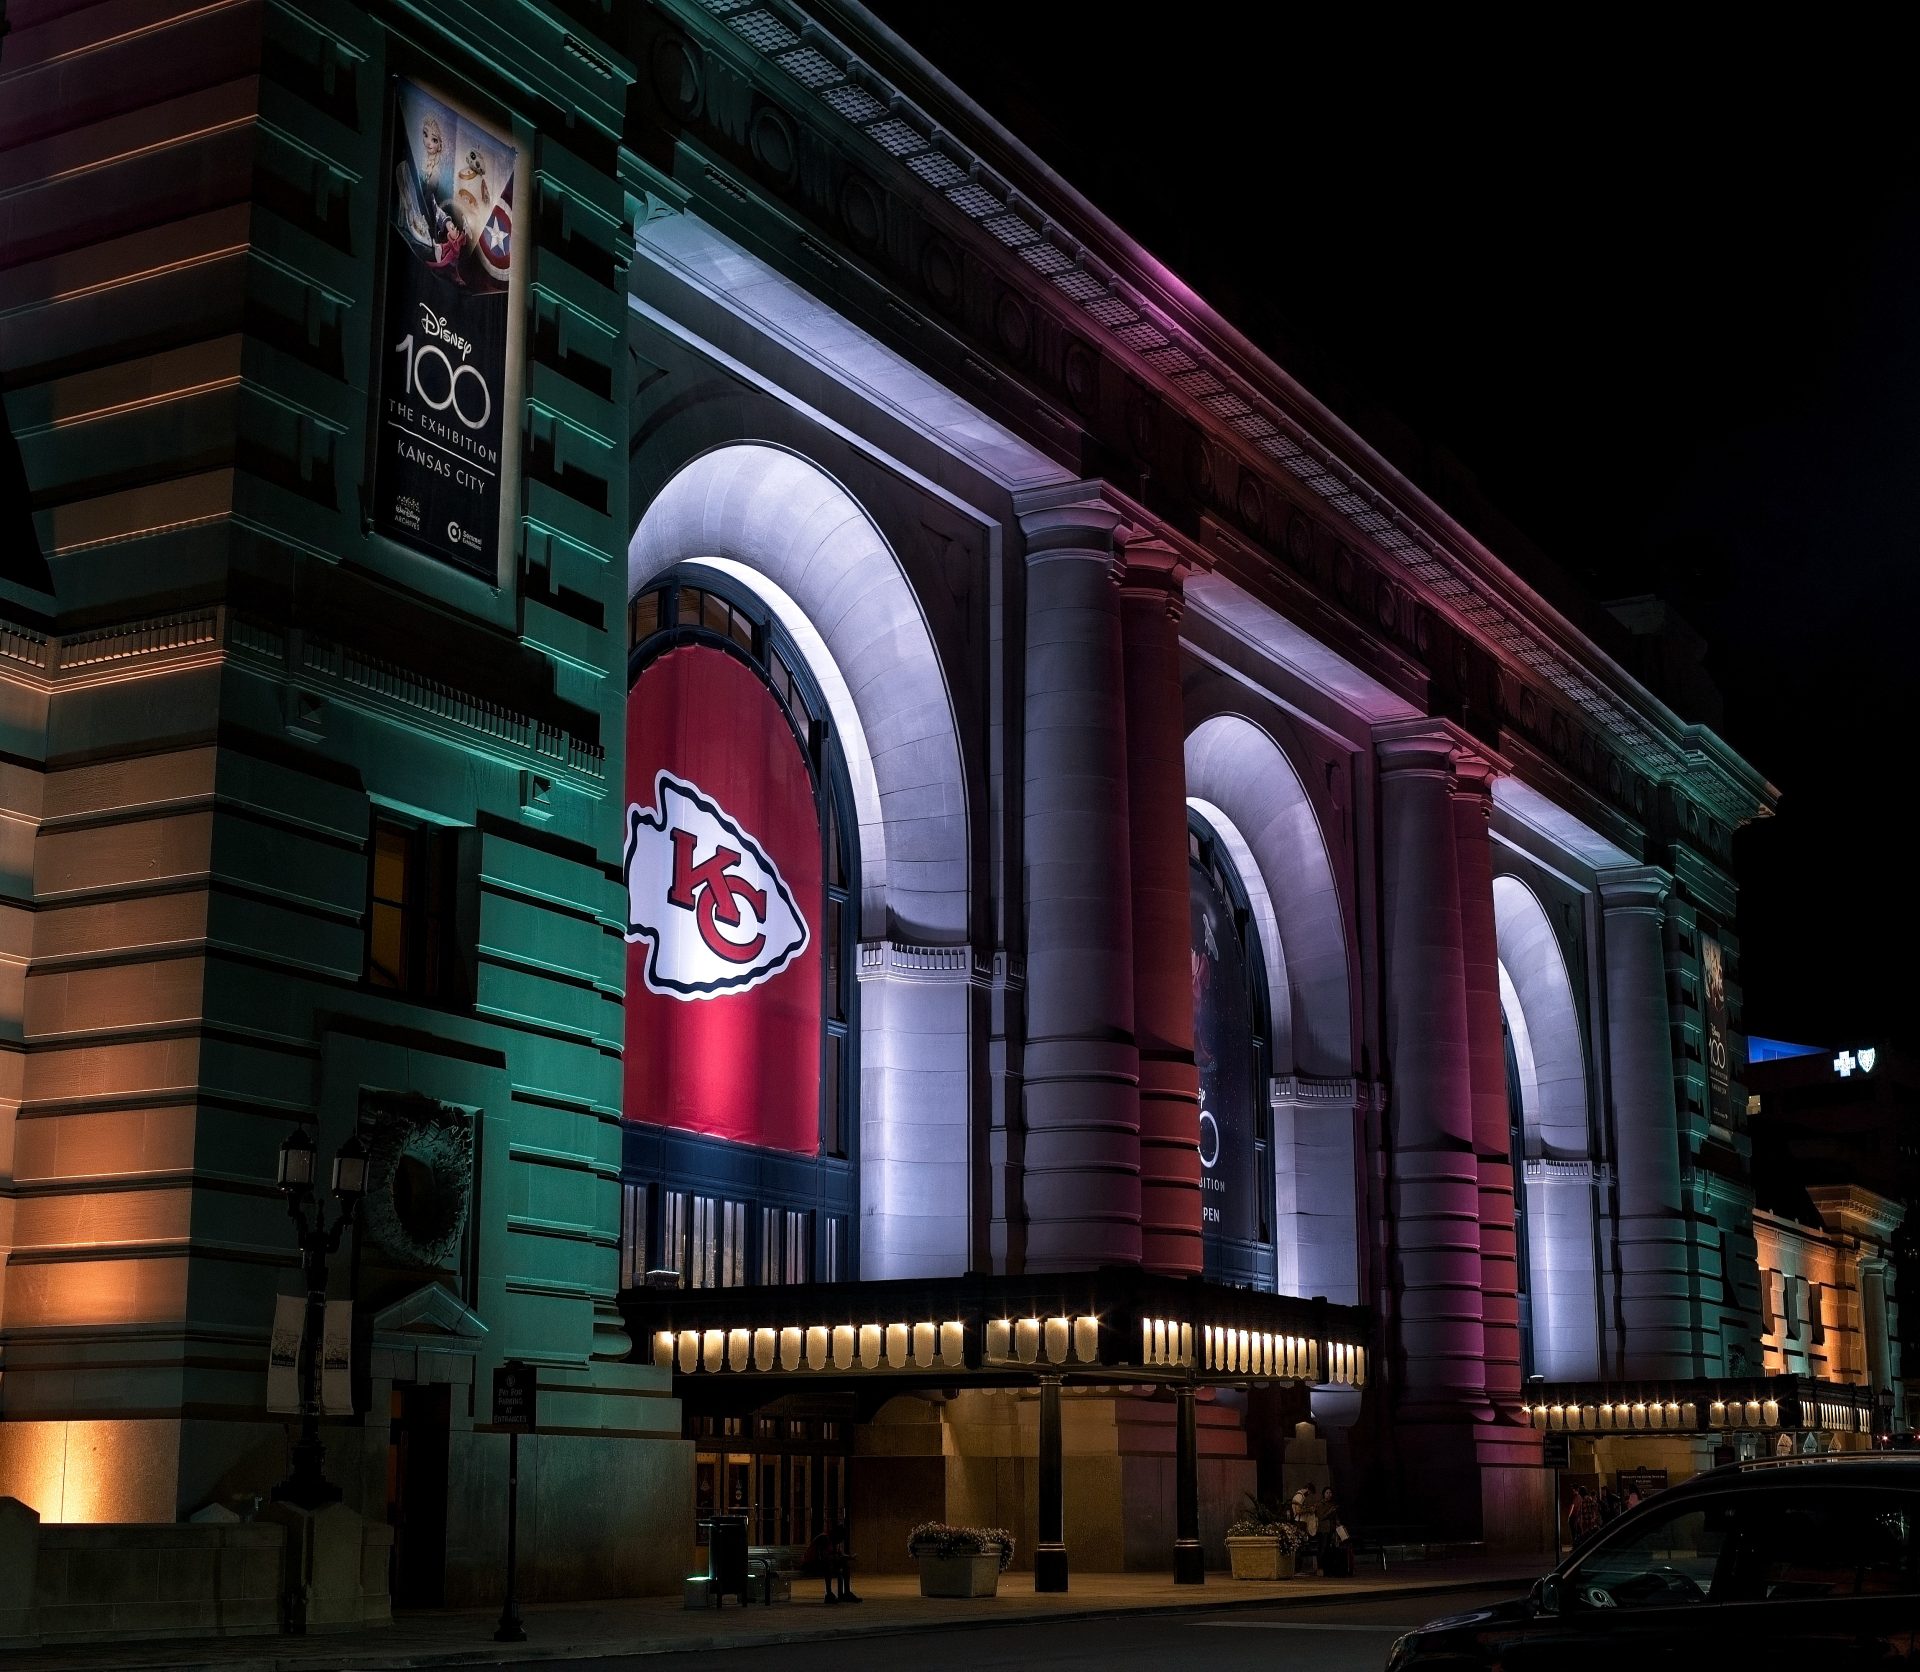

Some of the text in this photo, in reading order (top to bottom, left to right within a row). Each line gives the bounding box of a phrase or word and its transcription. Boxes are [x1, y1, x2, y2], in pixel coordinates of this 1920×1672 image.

[395, 333, 491, 429] 100
[388, 398, 497, 464] THE EXHIBITION
[397, 439, 485, 495] KANSAS CITY
[1708, 1037, 1726, 1069] 100
[1199, 1176, 1225, 1192] ITION
[1203, 1206, 1220, 1223] PEN
